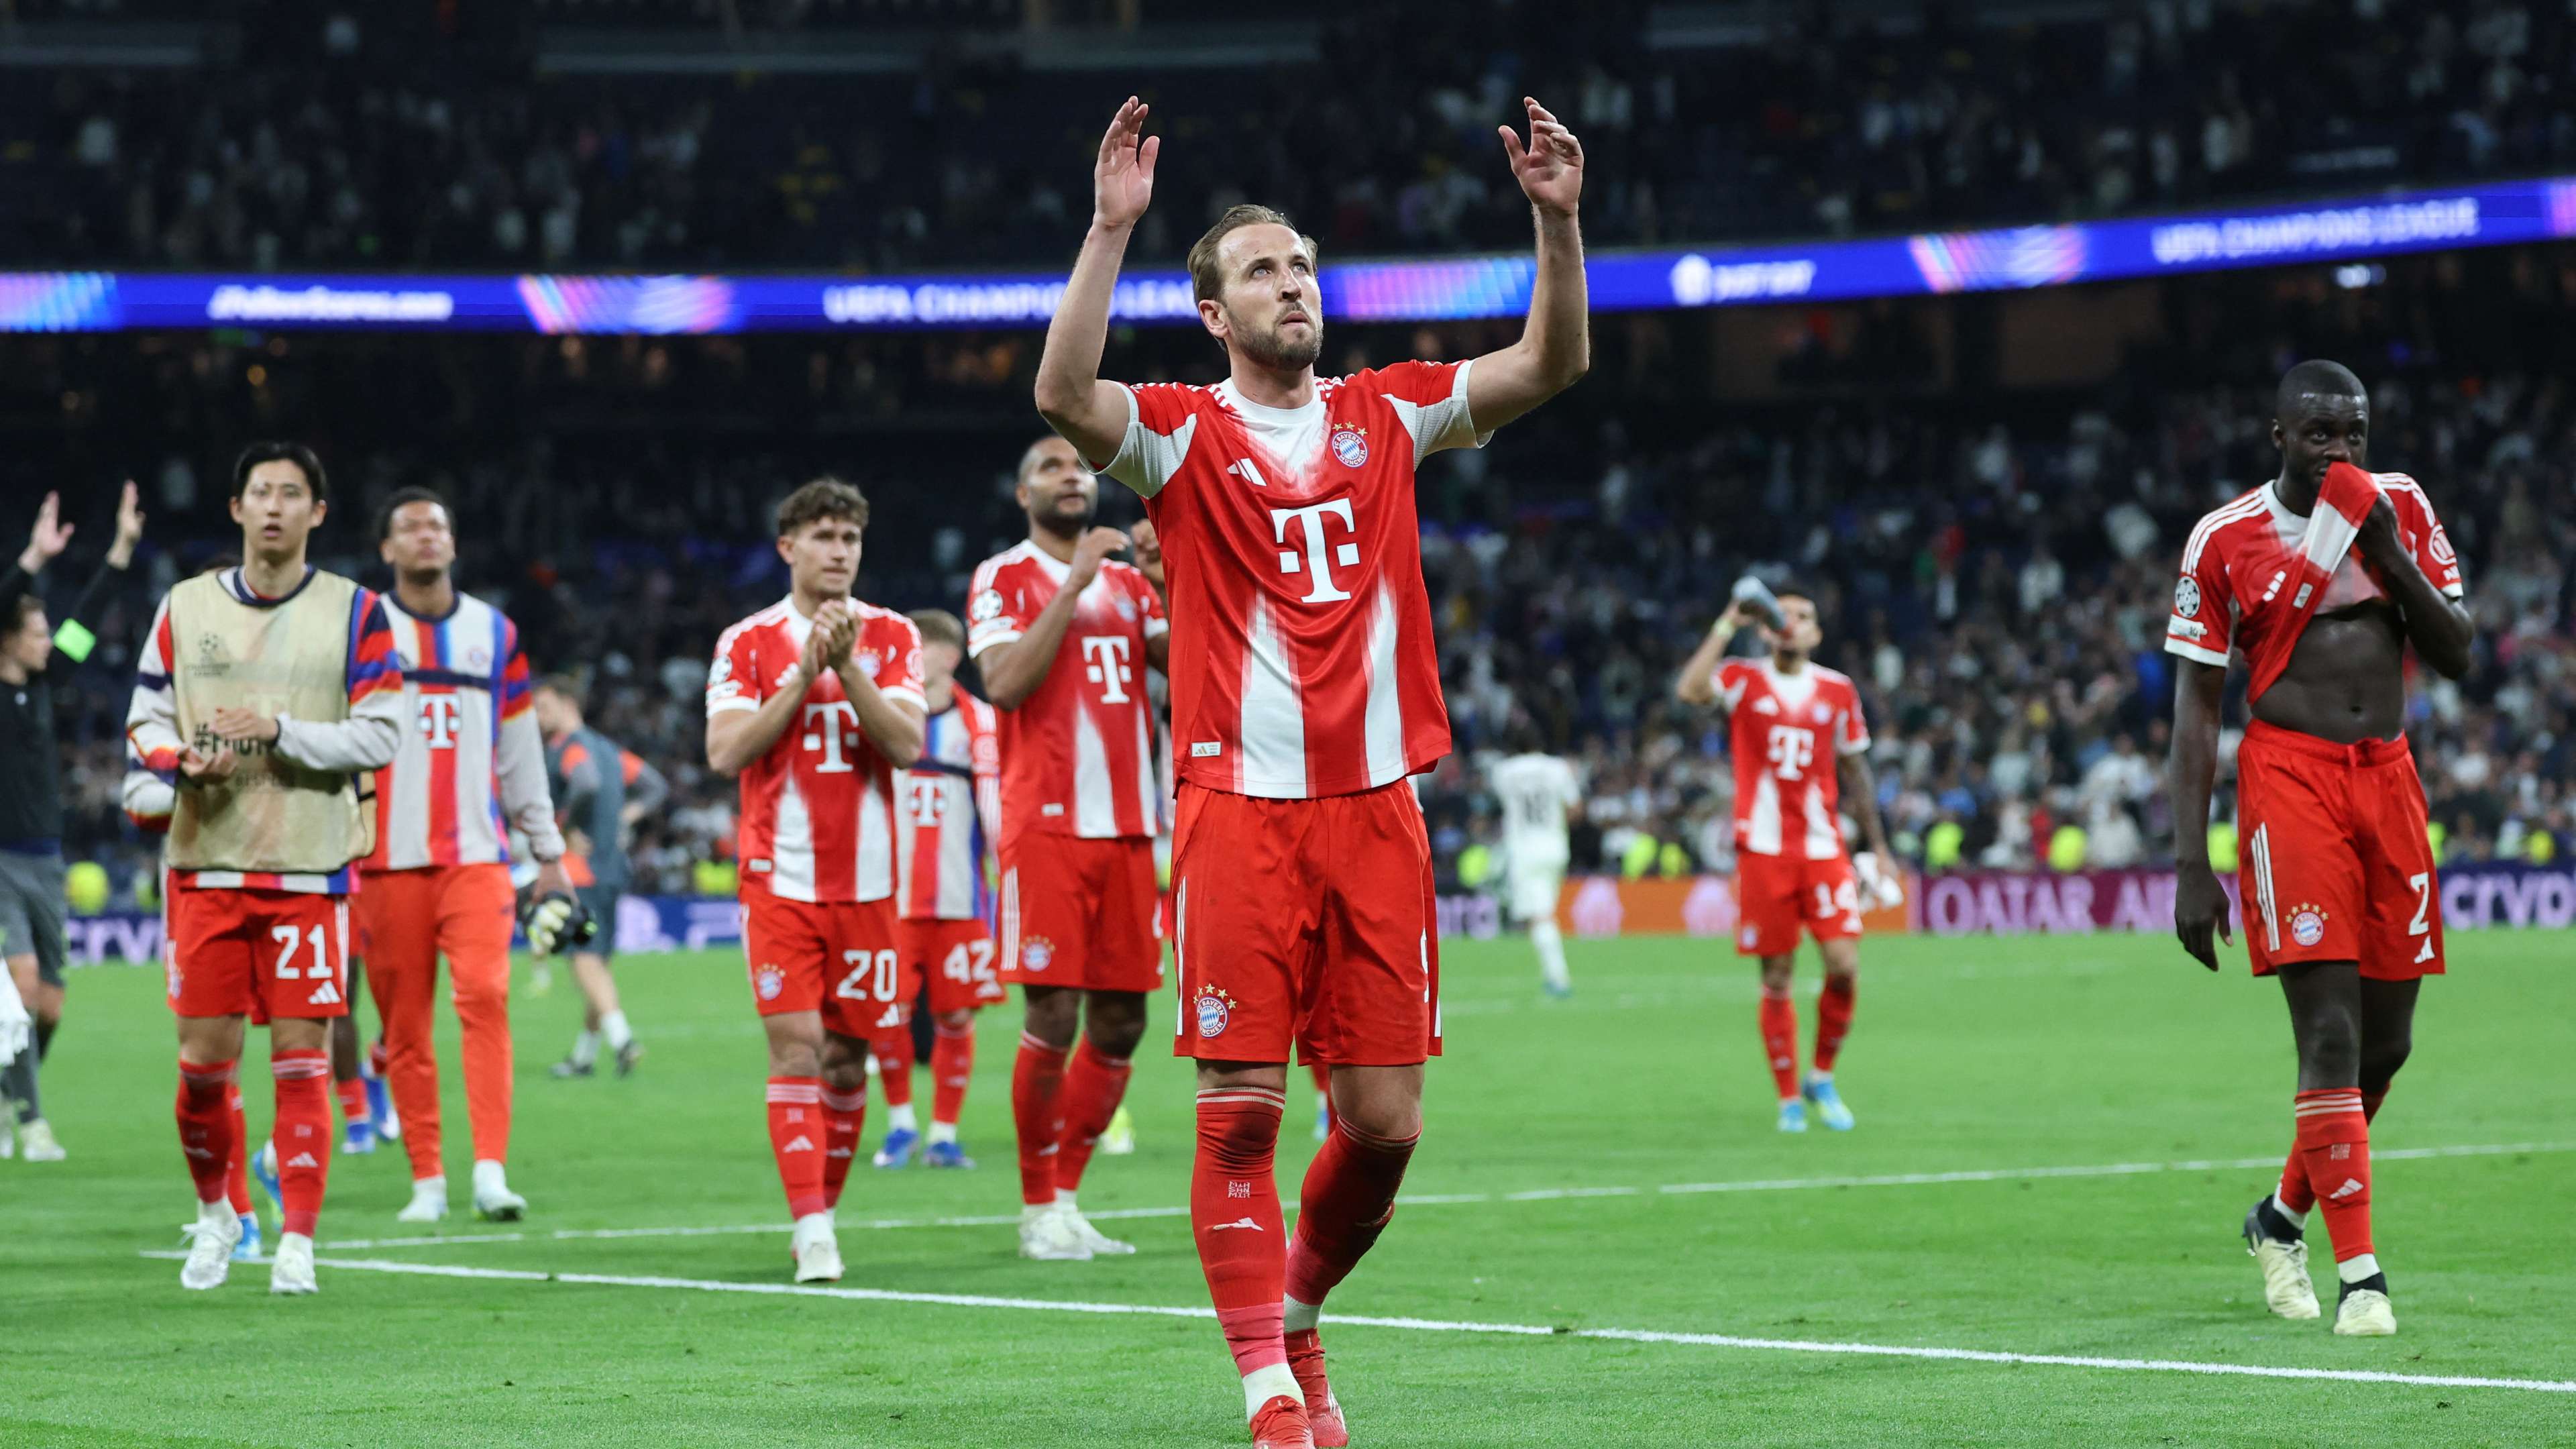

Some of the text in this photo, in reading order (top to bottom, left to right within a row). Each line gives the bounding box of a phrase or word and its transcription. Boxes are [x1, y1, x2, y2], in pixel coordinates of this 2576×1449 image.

[1337, 433, 1361, 444] BAYERN
[1270, 498, 1360, 603] T
[1081, 635, 1132, 704] T
[418, 694, 462, 748] T
[803, 700, 859, 773] T
[1767, 725, 1815, 781] T
[908, 779, 947, 826] T
[1814, 880, 1858, 920] 14
[2408, 871, 2430, 936] 2
[271, 924, 333, 979] 21
[837, 949, 898, 1002] 20
[943, 939, 997, 984] 42
[1202, 1000, 1224, 1015] BAYERN
